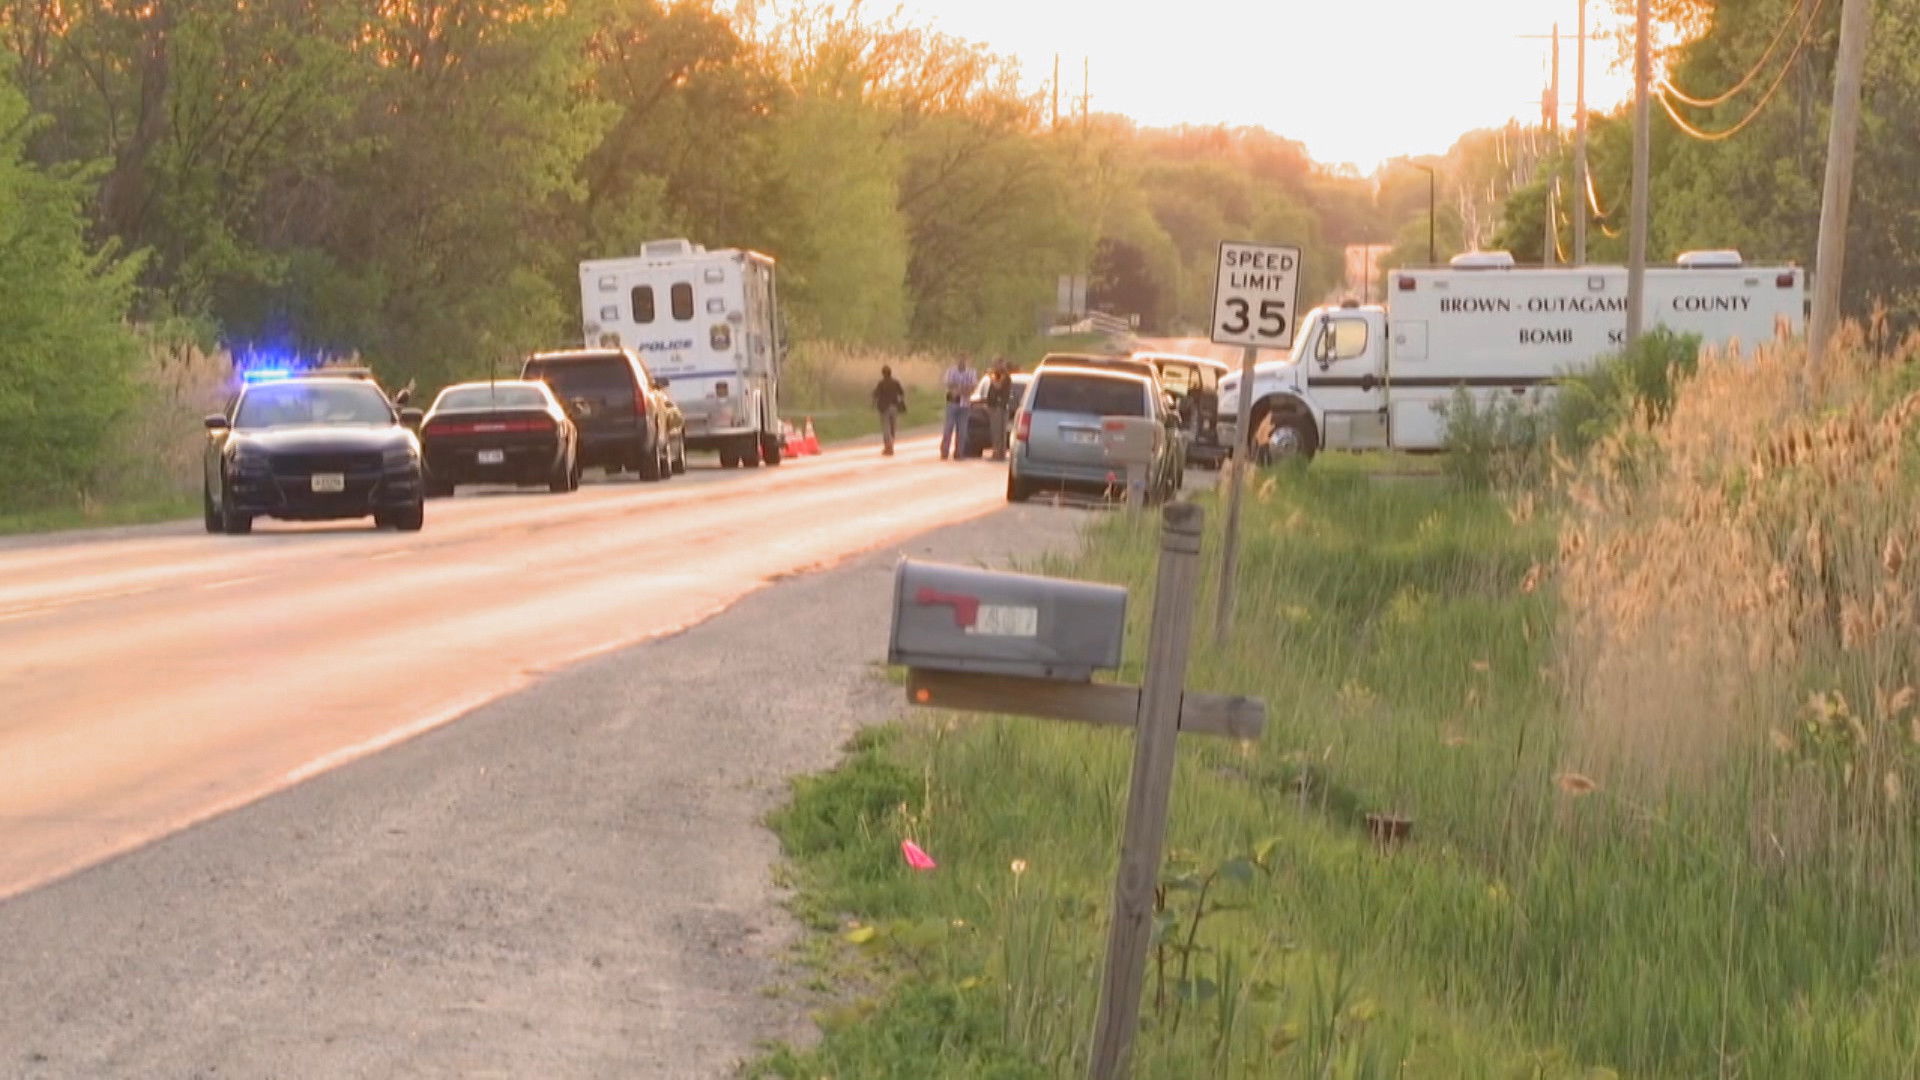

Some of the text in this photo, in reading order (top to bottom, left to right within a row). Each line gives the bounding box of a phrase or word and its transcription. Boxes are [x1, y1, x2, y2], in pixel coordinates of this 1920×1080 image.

[1226, 250, 1293, 271] SPEED
[1231, 272, 1282, 291] LIMIT
[1440, 297, 1511, 312] BROWN
[1673, 296, 1751, 311] COUNTY
[1222, 296, 1286, 337] 35
[1519, 329, 1573, 344] BOMB
[638, 339, 693, 352] POLICE
